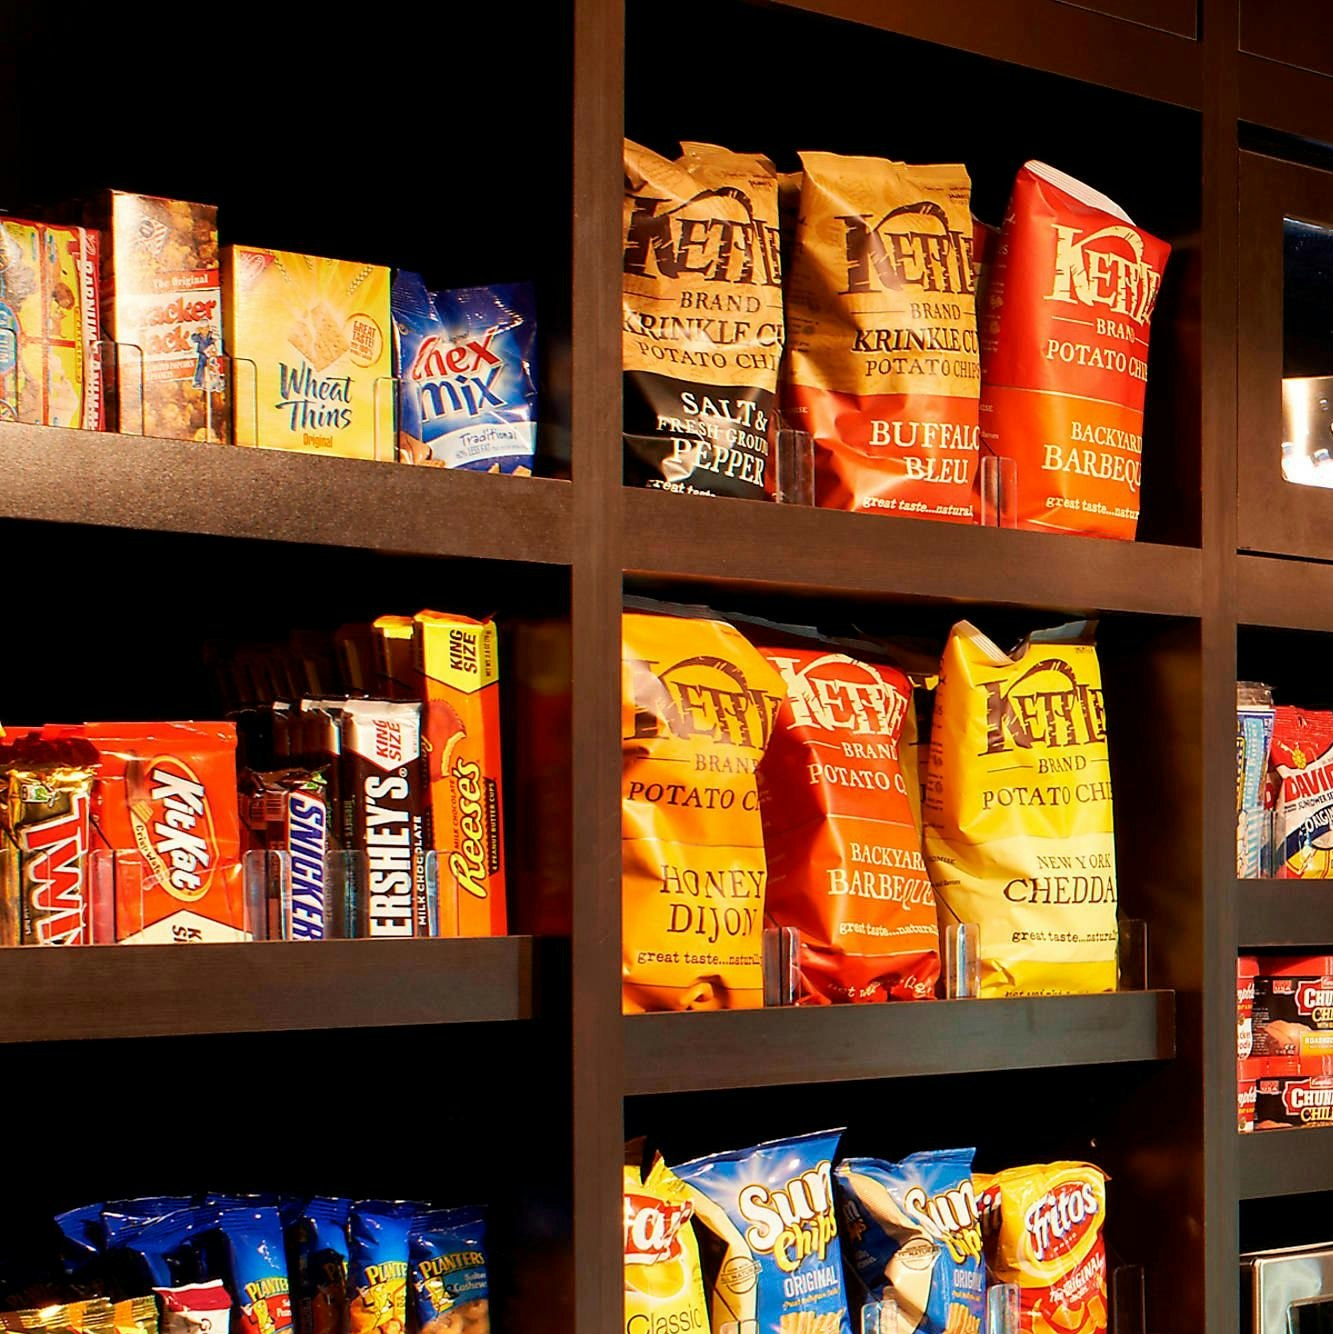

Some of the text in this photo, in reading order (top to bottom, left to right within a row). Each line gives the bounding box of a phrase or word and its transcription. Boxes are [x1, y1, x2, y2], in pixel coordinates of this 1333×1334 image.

[172, 274, 209, 287] Original
[680, 291, 760, 313] BRAND
[910, 302, 961, 321] BRAND
[623, 311, 751, 345] KRINKLE
[852, 328, 960, 353] KRINKLE
[637, 341, 726, 368] POTATO
[865, 358, 949, 377] POTATO
[1047, 339, 1126, 373] POTATO
[278, 362, 355, 404] Wheat
[421, 367, 507, 424] mix
[275, 400, 352, 431] Thins
[681, 391, 756, 427] SALT
[303, 433, 333, 448] Original
[459, 427, 517, 446] Traditional
[657, 415, 719, 440] FRESH
[1071, 421, 1143, 454] BACKYARD
[671, 437, 764, 488] PEPPER
[904, 456, 968, 484] BLEU
[862, 495, 897, 510] great
[1046, 496, 1081, 510] great
[449, 629, 463, 671] KING
[464, 632, 478, 674] SIZE
[375, 719, 388, 758] KING
[388, 721, 401, 761] SIZE
[809, 763, 890, 791] POTATO
[1038, 756, 1087, 774] BRAND
[628, 782, 735, 810] POTATO
[982, 785, 1071, 810] POTATO
[450, 757, 488, 898] Reese's
[412, 815, 427, 927] MILK CHOCOLATE
[1038, 855, 1072, 869] NEW
[660, 864, 766, 899] HONEY
[667, 903, 757, 943] DIJON
[838, 922, 866, 935] great
[1011, 930, 1047, 944] great
[637, 950, 680, 965] great
[739, 1159, 833, 1255] Sun
[904, 1179, 979, 1242] Sun
[1025, 1182, 1099, 1261] Fritos
[419, 1251, 486, 1279] PLANTERS
[1063, 1254, 1105, 1296] ORIGINAL
[783, 1265, 839, 1299] ORIGINAL
